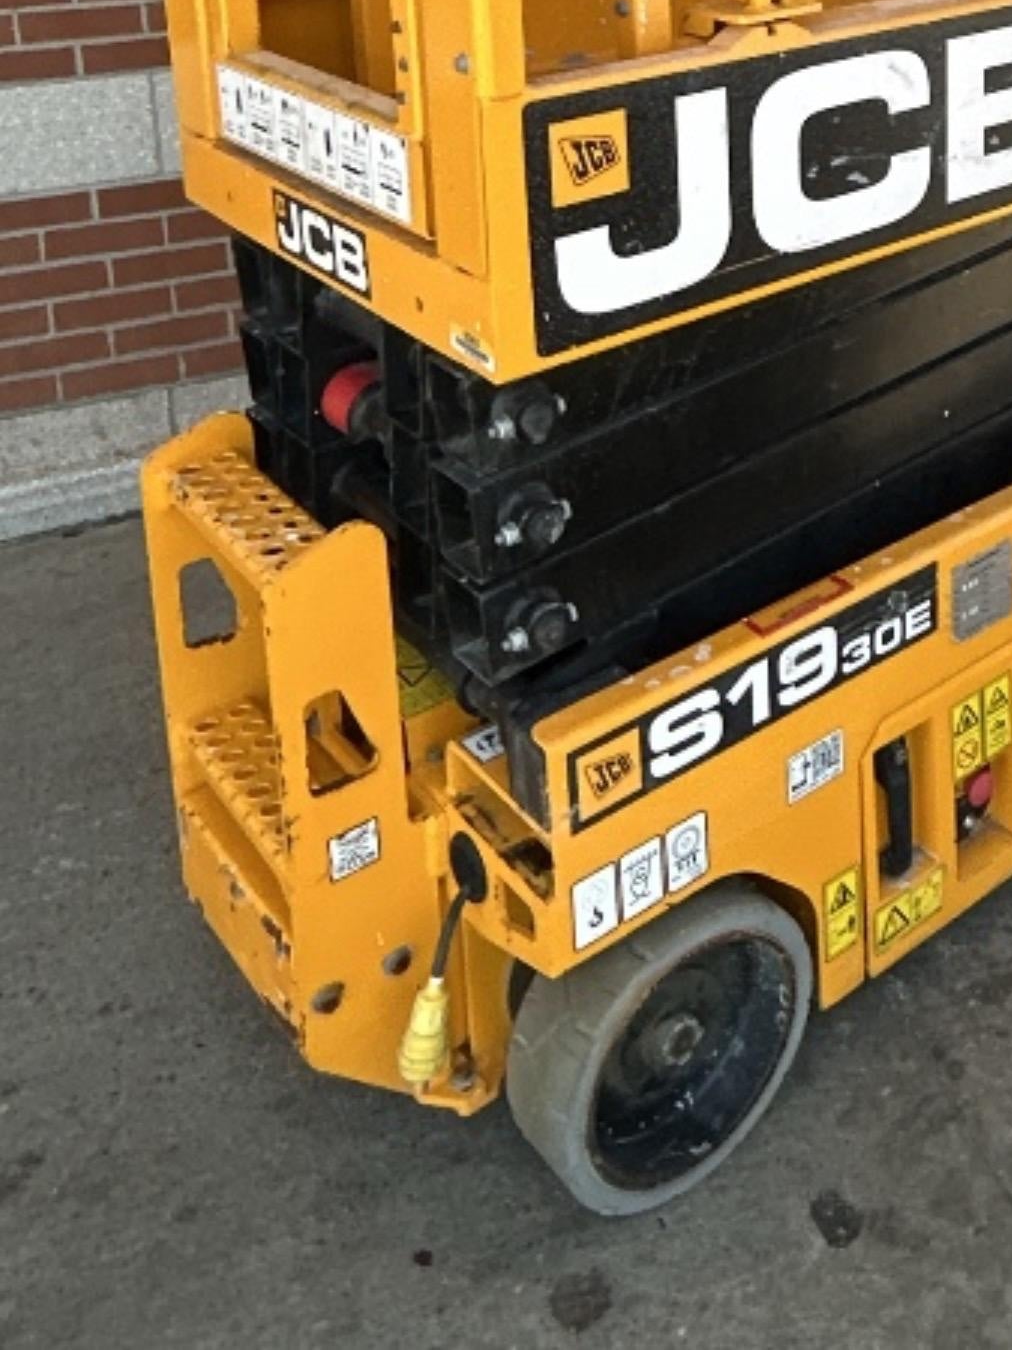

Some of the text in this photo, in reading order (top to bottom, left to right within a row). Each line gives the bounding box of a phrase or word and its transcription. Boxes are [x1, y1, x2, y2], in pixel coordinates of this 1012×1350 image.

[570, 140, 616, 181] JCB
[277, 200, 368, 293] JCB
[592, 754, 632, 792] JCB
